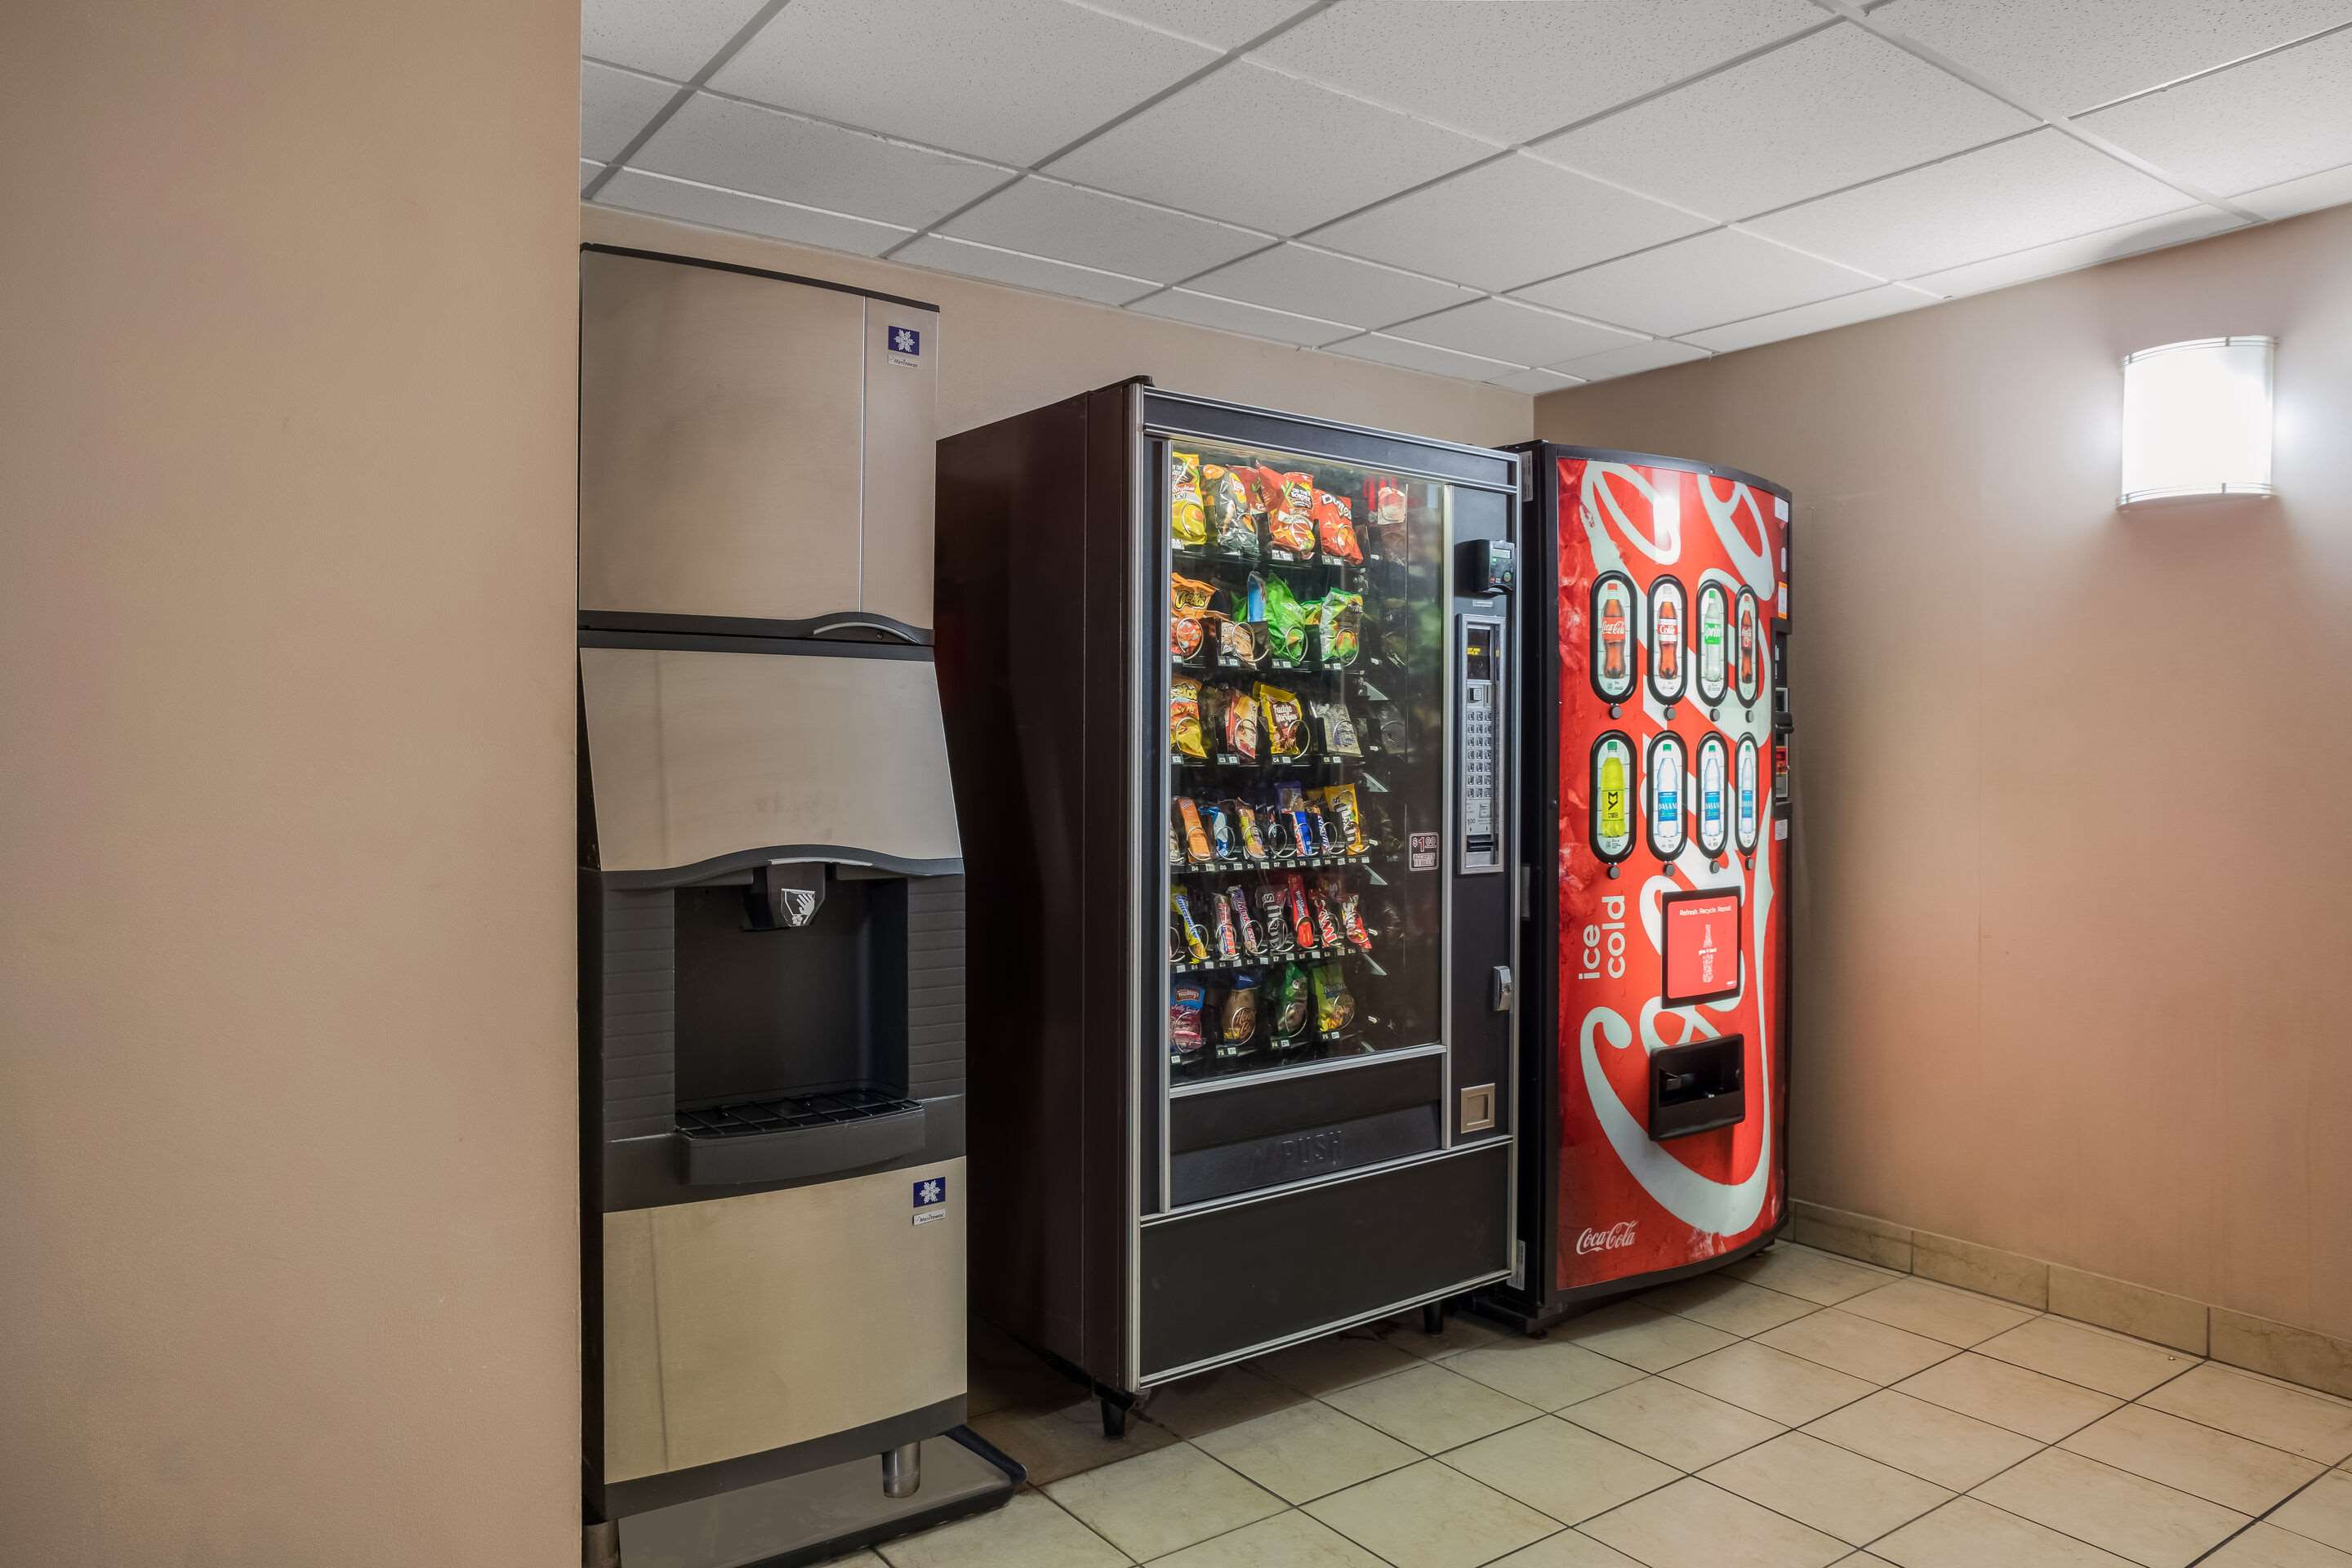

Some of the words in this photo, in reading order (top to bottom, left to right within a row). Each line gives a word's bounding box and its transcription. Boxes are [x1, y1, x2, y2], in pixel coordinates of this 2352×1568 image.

[1579, 924, 1600, 980] ice
[1601, 895, 1626, 979] cold
[1281, 1130, 1343, 1165] PUSH
[1576, 1220, 1639, 1254] Coca-Cola
